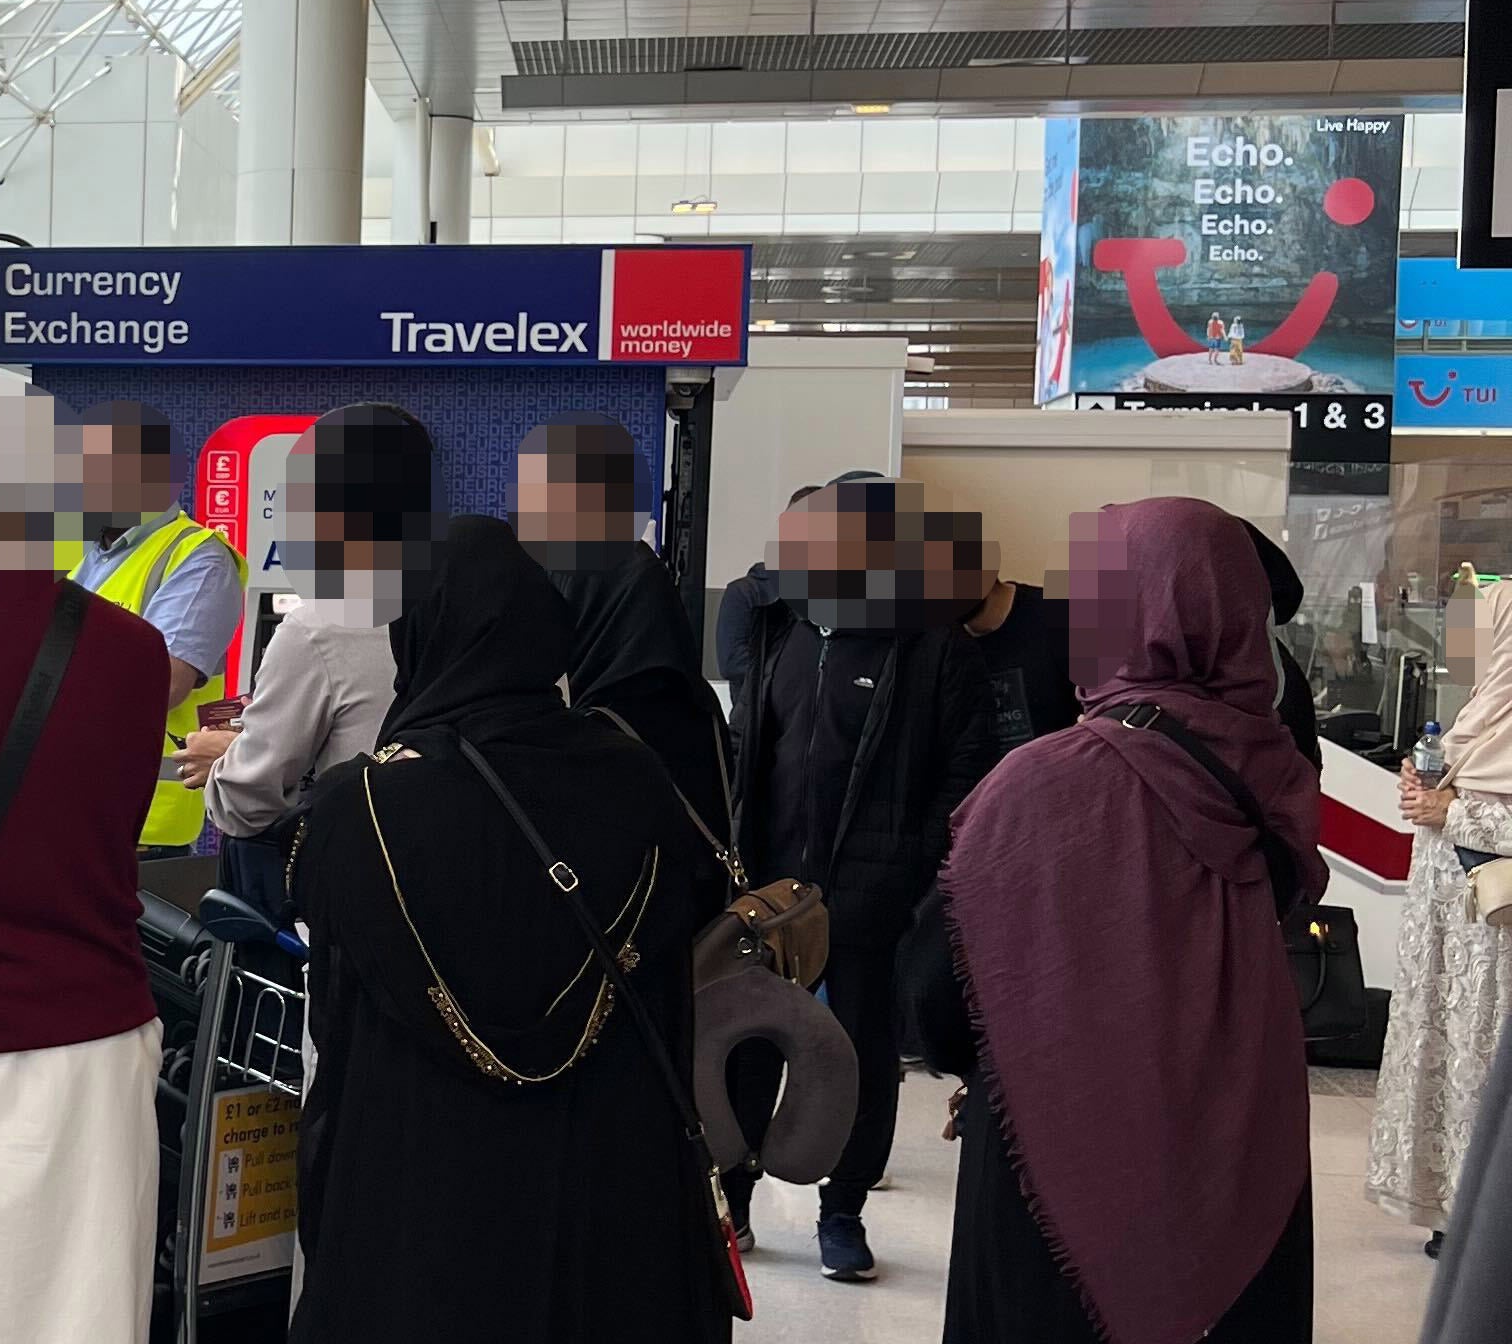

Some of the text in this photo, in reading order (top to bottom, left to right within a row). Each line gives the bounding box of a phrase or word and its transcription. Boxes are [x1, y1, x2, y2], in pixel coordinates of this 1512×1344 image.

[1316, 118, 1391, 134] Live Happy
[1185, 136, 1294, 167] Echo.
[1193, 178, 1283, 205] Echo.
[1201, 213, 1274, 236] Echo.
[1209, 244, 1264, 262] Echo.
[4, 263, 182, 305] Currency
[3, 311, 190, 354] Exchange
[380, 311, 589, 354] Travelex
[619, 320, 733, 339] worldwide
[619, 340, 693, 359] money
[1463, 388, 1497, 403] TUI
[1294, 402, 1308, 428] 1
[1324, 402, 1347, 429] &
[1364, 402, 1386, 429] 3
[223, 1126, 268, 1144] charge
